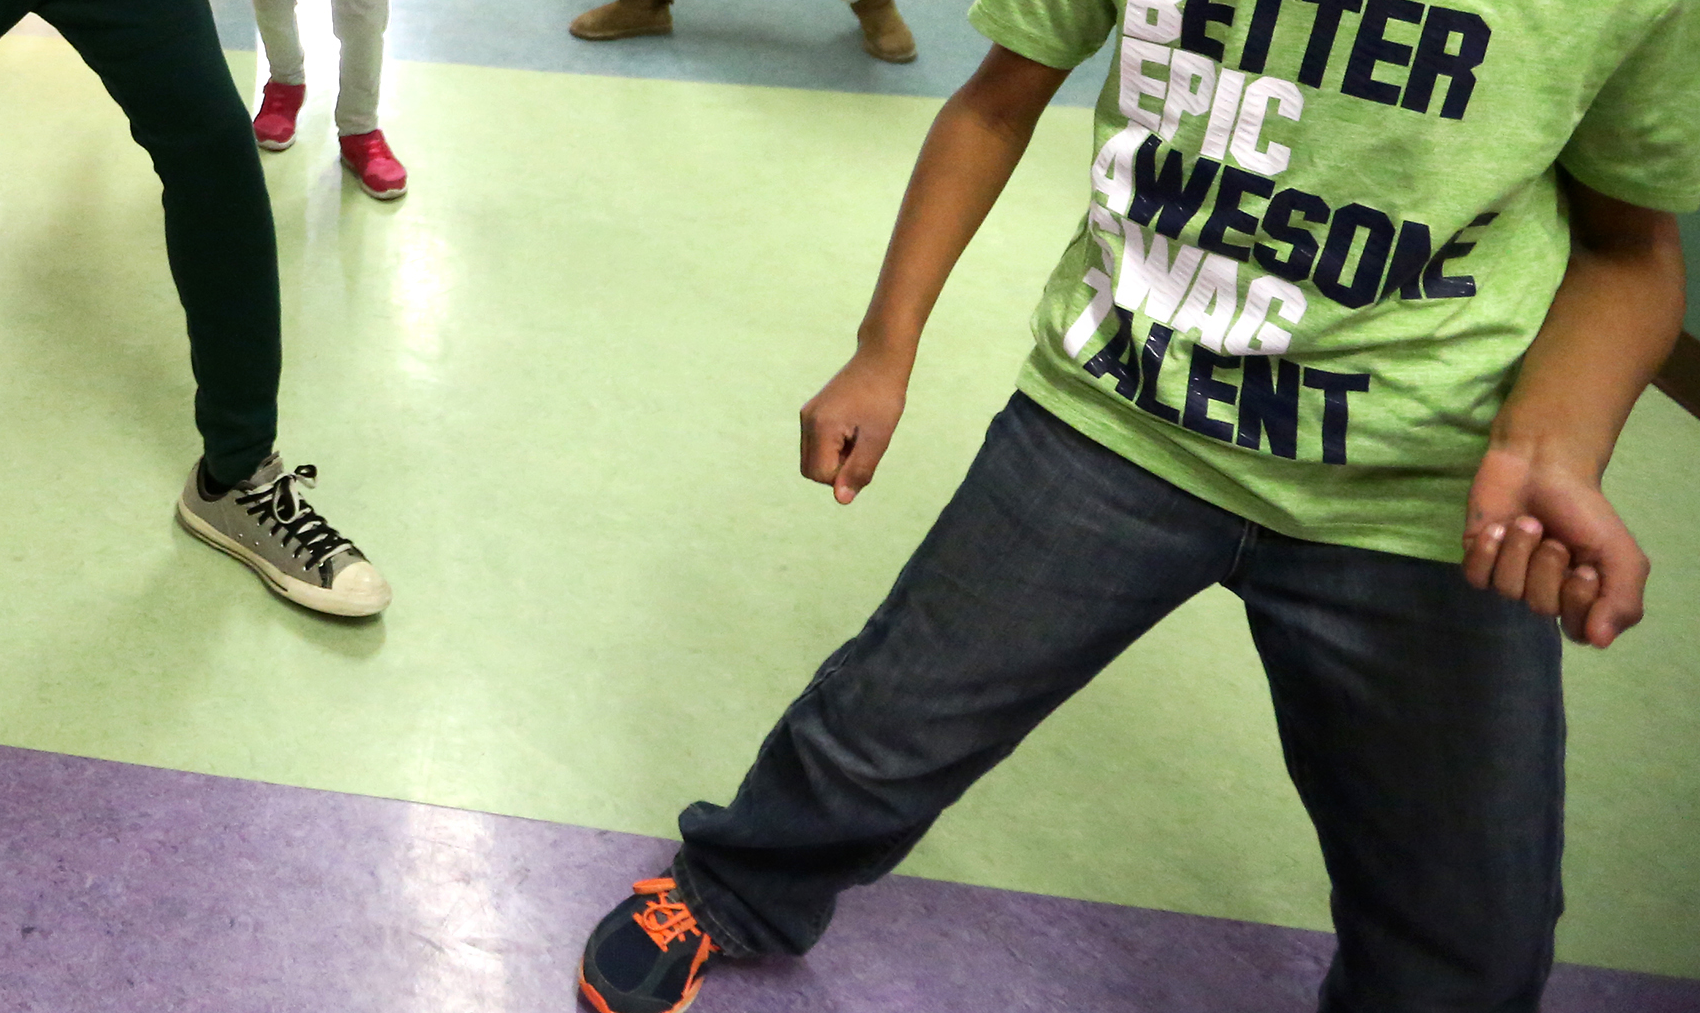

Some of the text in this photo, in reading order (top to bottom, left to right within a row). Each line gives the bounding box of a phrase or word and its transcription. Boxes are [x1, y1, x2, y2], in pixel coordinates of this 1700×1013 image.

[1119, 36, 1304, 175] EPIC
[1089, 200, 1308, 356] SWAG
[1090, 126, 1500, 309] AWESOME
[1064, 267, 1370, 465] TALENT
